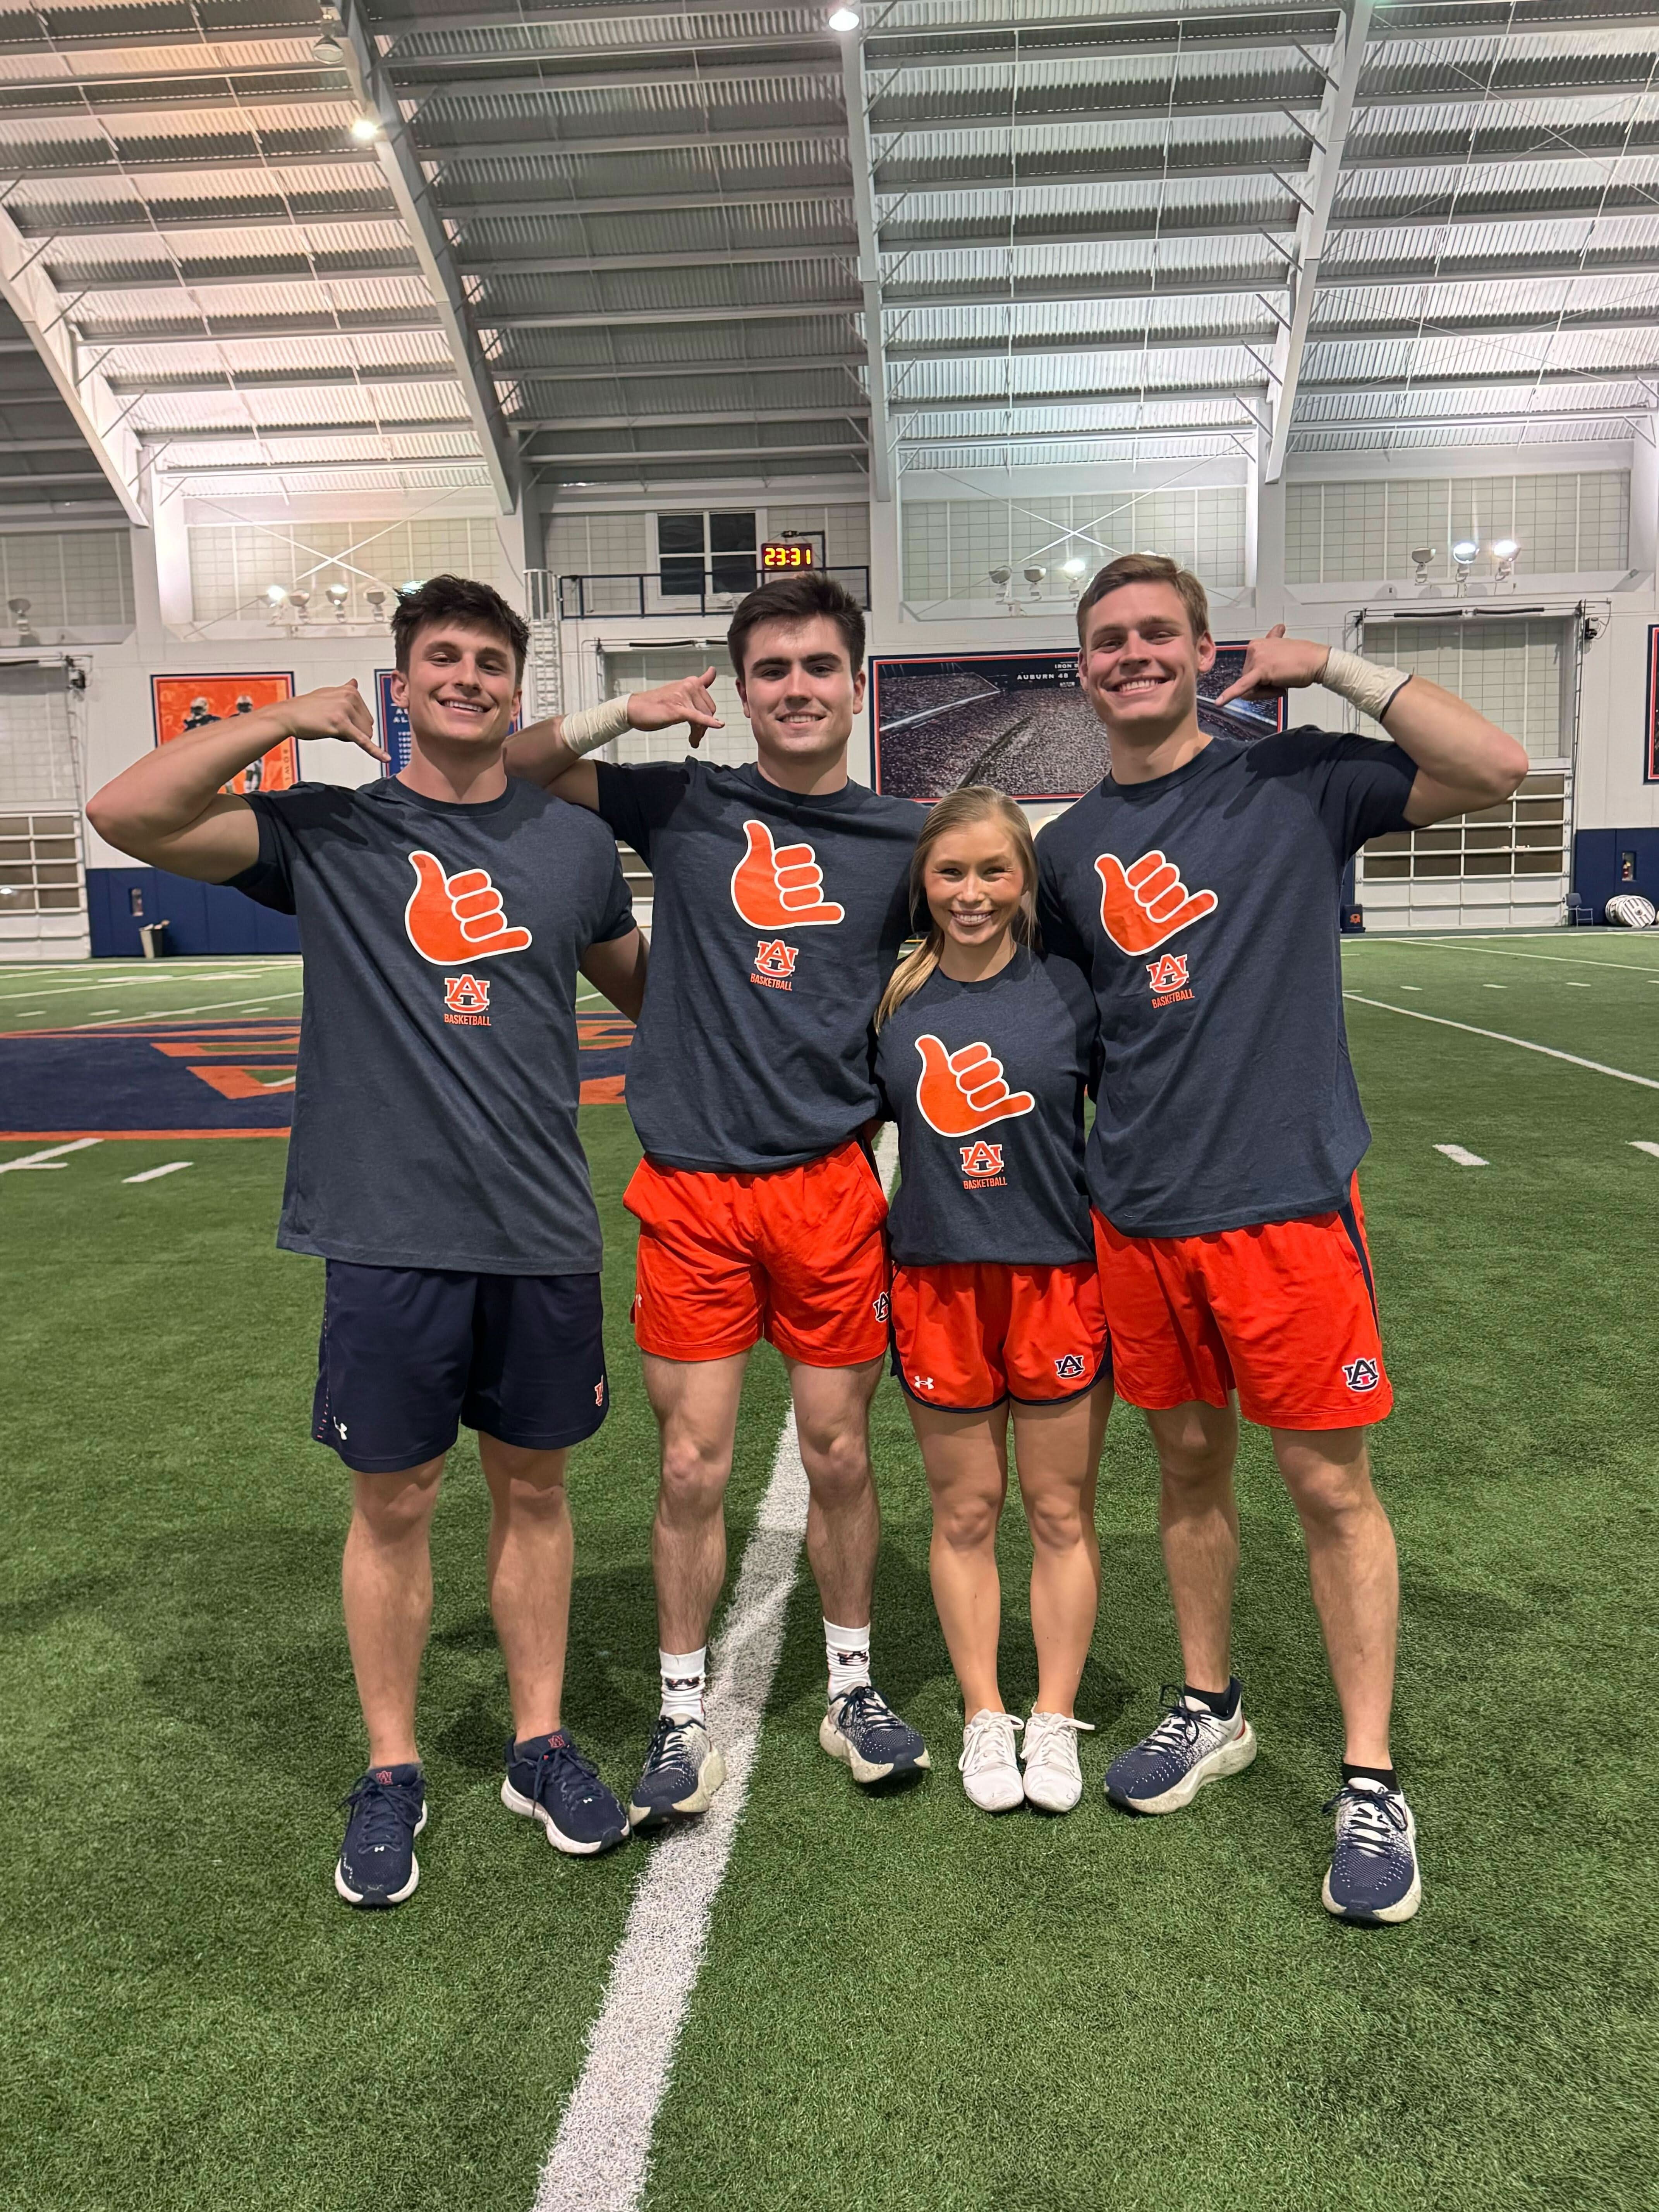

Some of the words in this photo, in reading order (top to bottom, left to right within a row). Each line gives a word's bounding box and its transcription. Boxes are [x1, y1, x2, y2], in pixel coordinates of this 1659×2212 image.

[764, 548, 811, 565] 23:31
[750, 973, 793, 991] BASKETBALL
[1151, 988, 1195, 1009] BASKETBALL
[444, 1013, 491, 1026] BASKETBALL
[963, 1176, 1008, 1190] BASKETBALL
